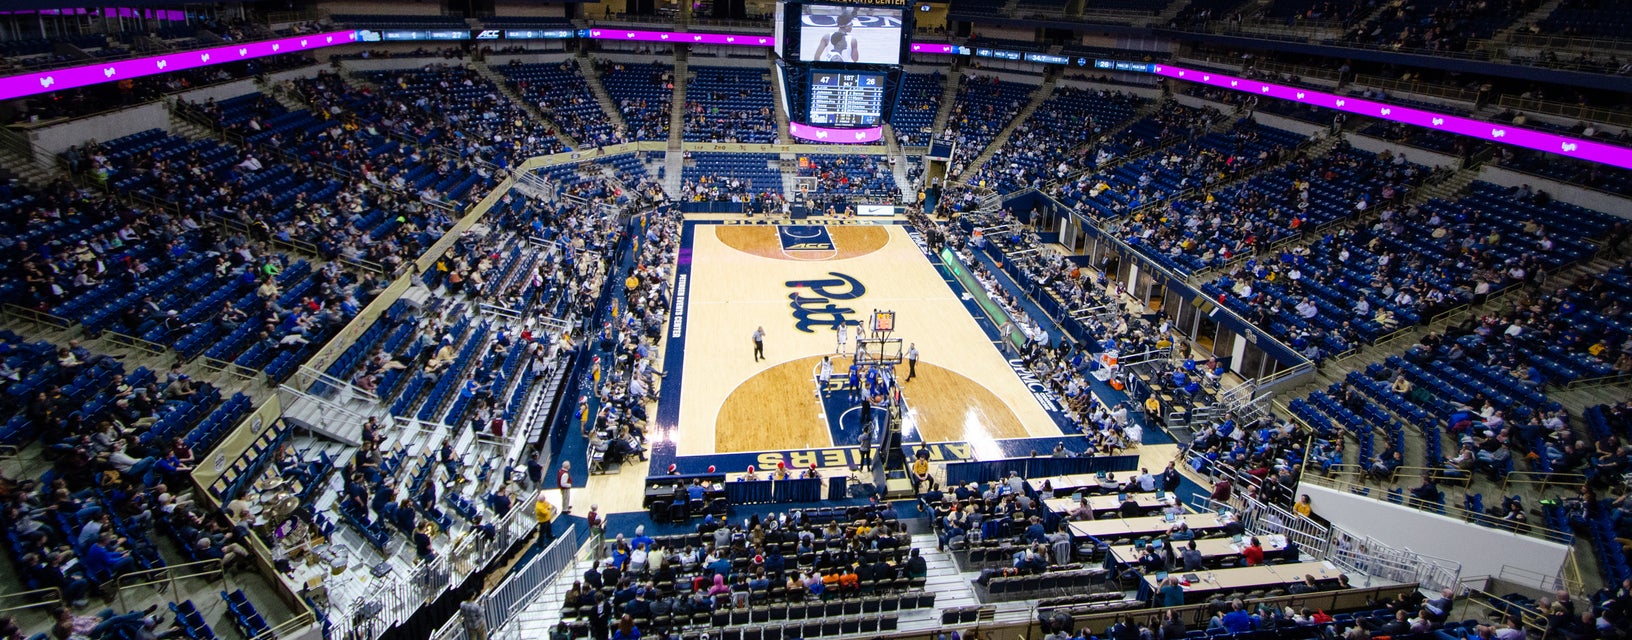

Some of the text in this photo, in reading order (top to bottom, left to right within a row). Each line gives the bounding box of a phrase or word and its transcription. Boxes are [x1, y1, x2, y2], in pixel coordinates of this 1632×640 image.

[476, 30, 500, 39] ACC
[820, 76, 830, 84] 47
[785, 242, 831, 250] ACC
[785, 271, 866, 334] Pitt
[1008, 358, 1048, 393] UPMC
